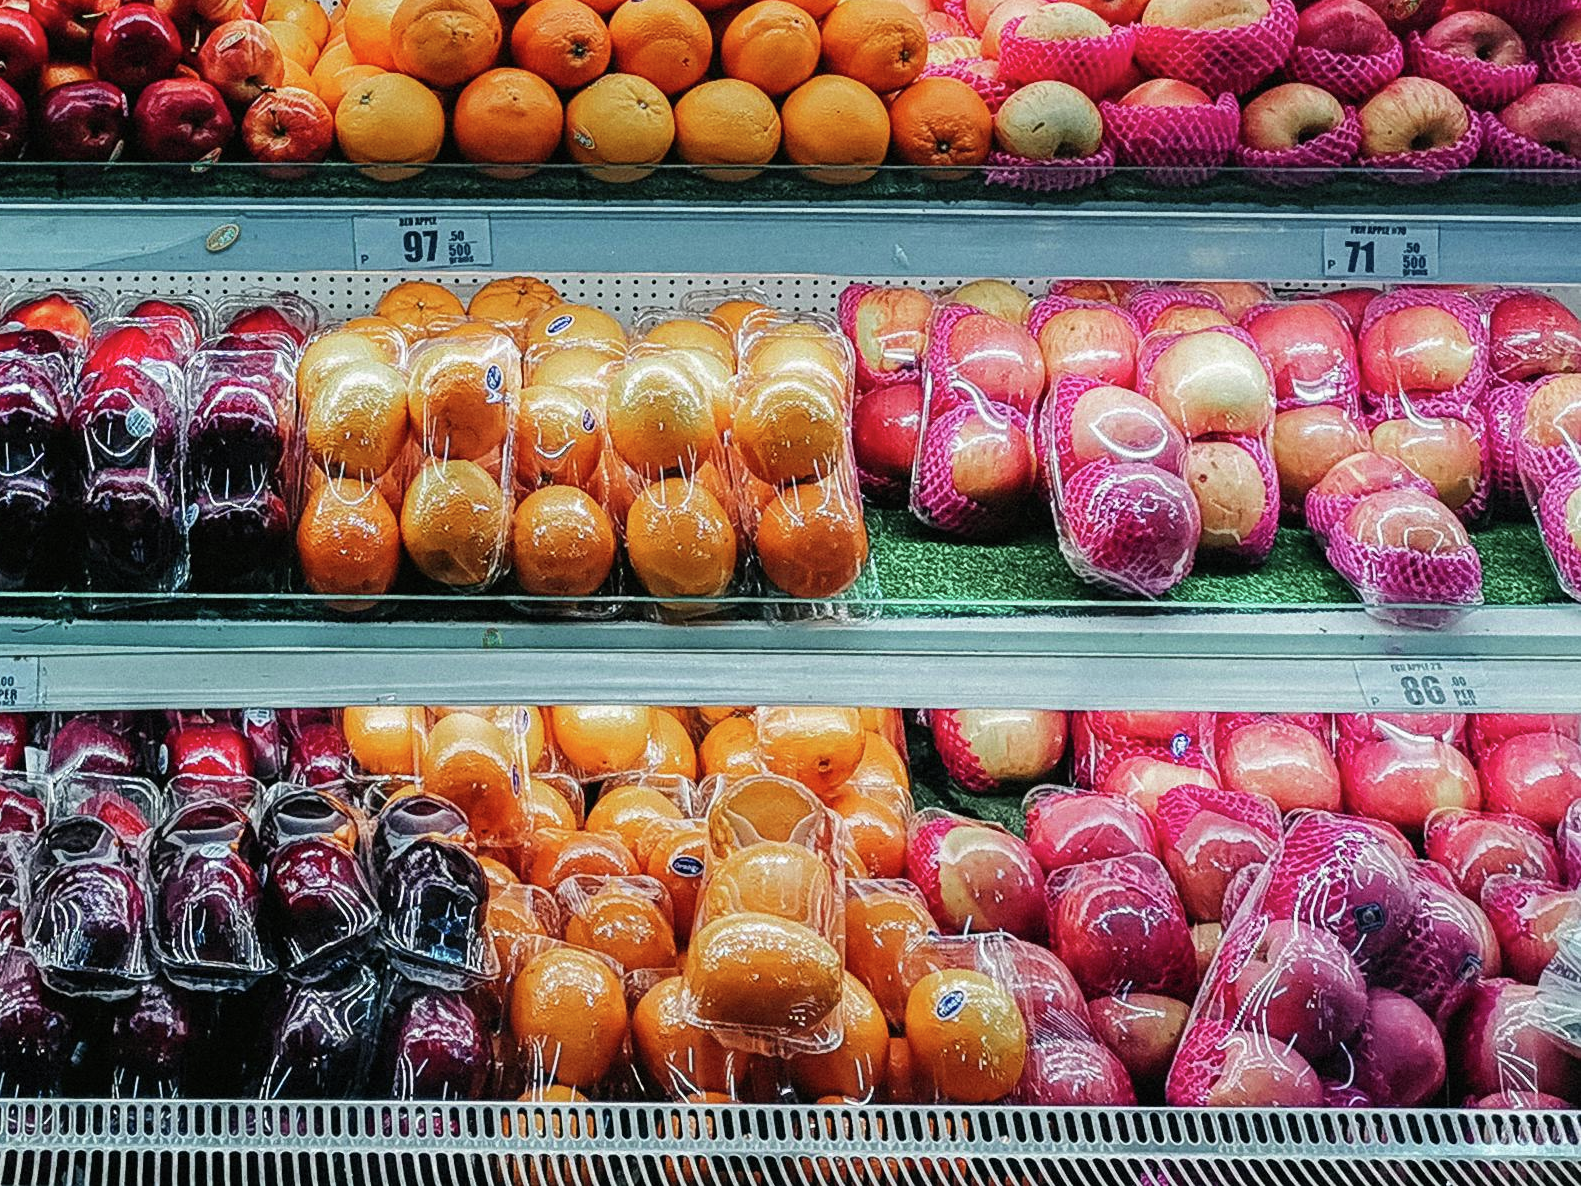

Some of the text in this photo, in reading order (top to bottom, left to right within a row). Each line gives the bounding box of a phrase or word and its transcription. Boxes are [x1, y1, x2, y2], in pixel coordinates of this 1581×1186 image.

[414, 217, 437, 226] APPLE
[1367, 225, 1390, 235] APPLE
[360, 230, 464, 264] P 97 .50
[448, 243, 471, 257] 500
[448, 256, 474, 264] grams
[1327, 241, 1420, 273] P 71 .50
[1402, 255, 1426, 269] 500
[1407, 662, 1430, 672] APPLE
[1371, 696, 1379, 706] P
[1400, 675, 1446, 706] 86
[1453, 688, 1476, 700] PER
